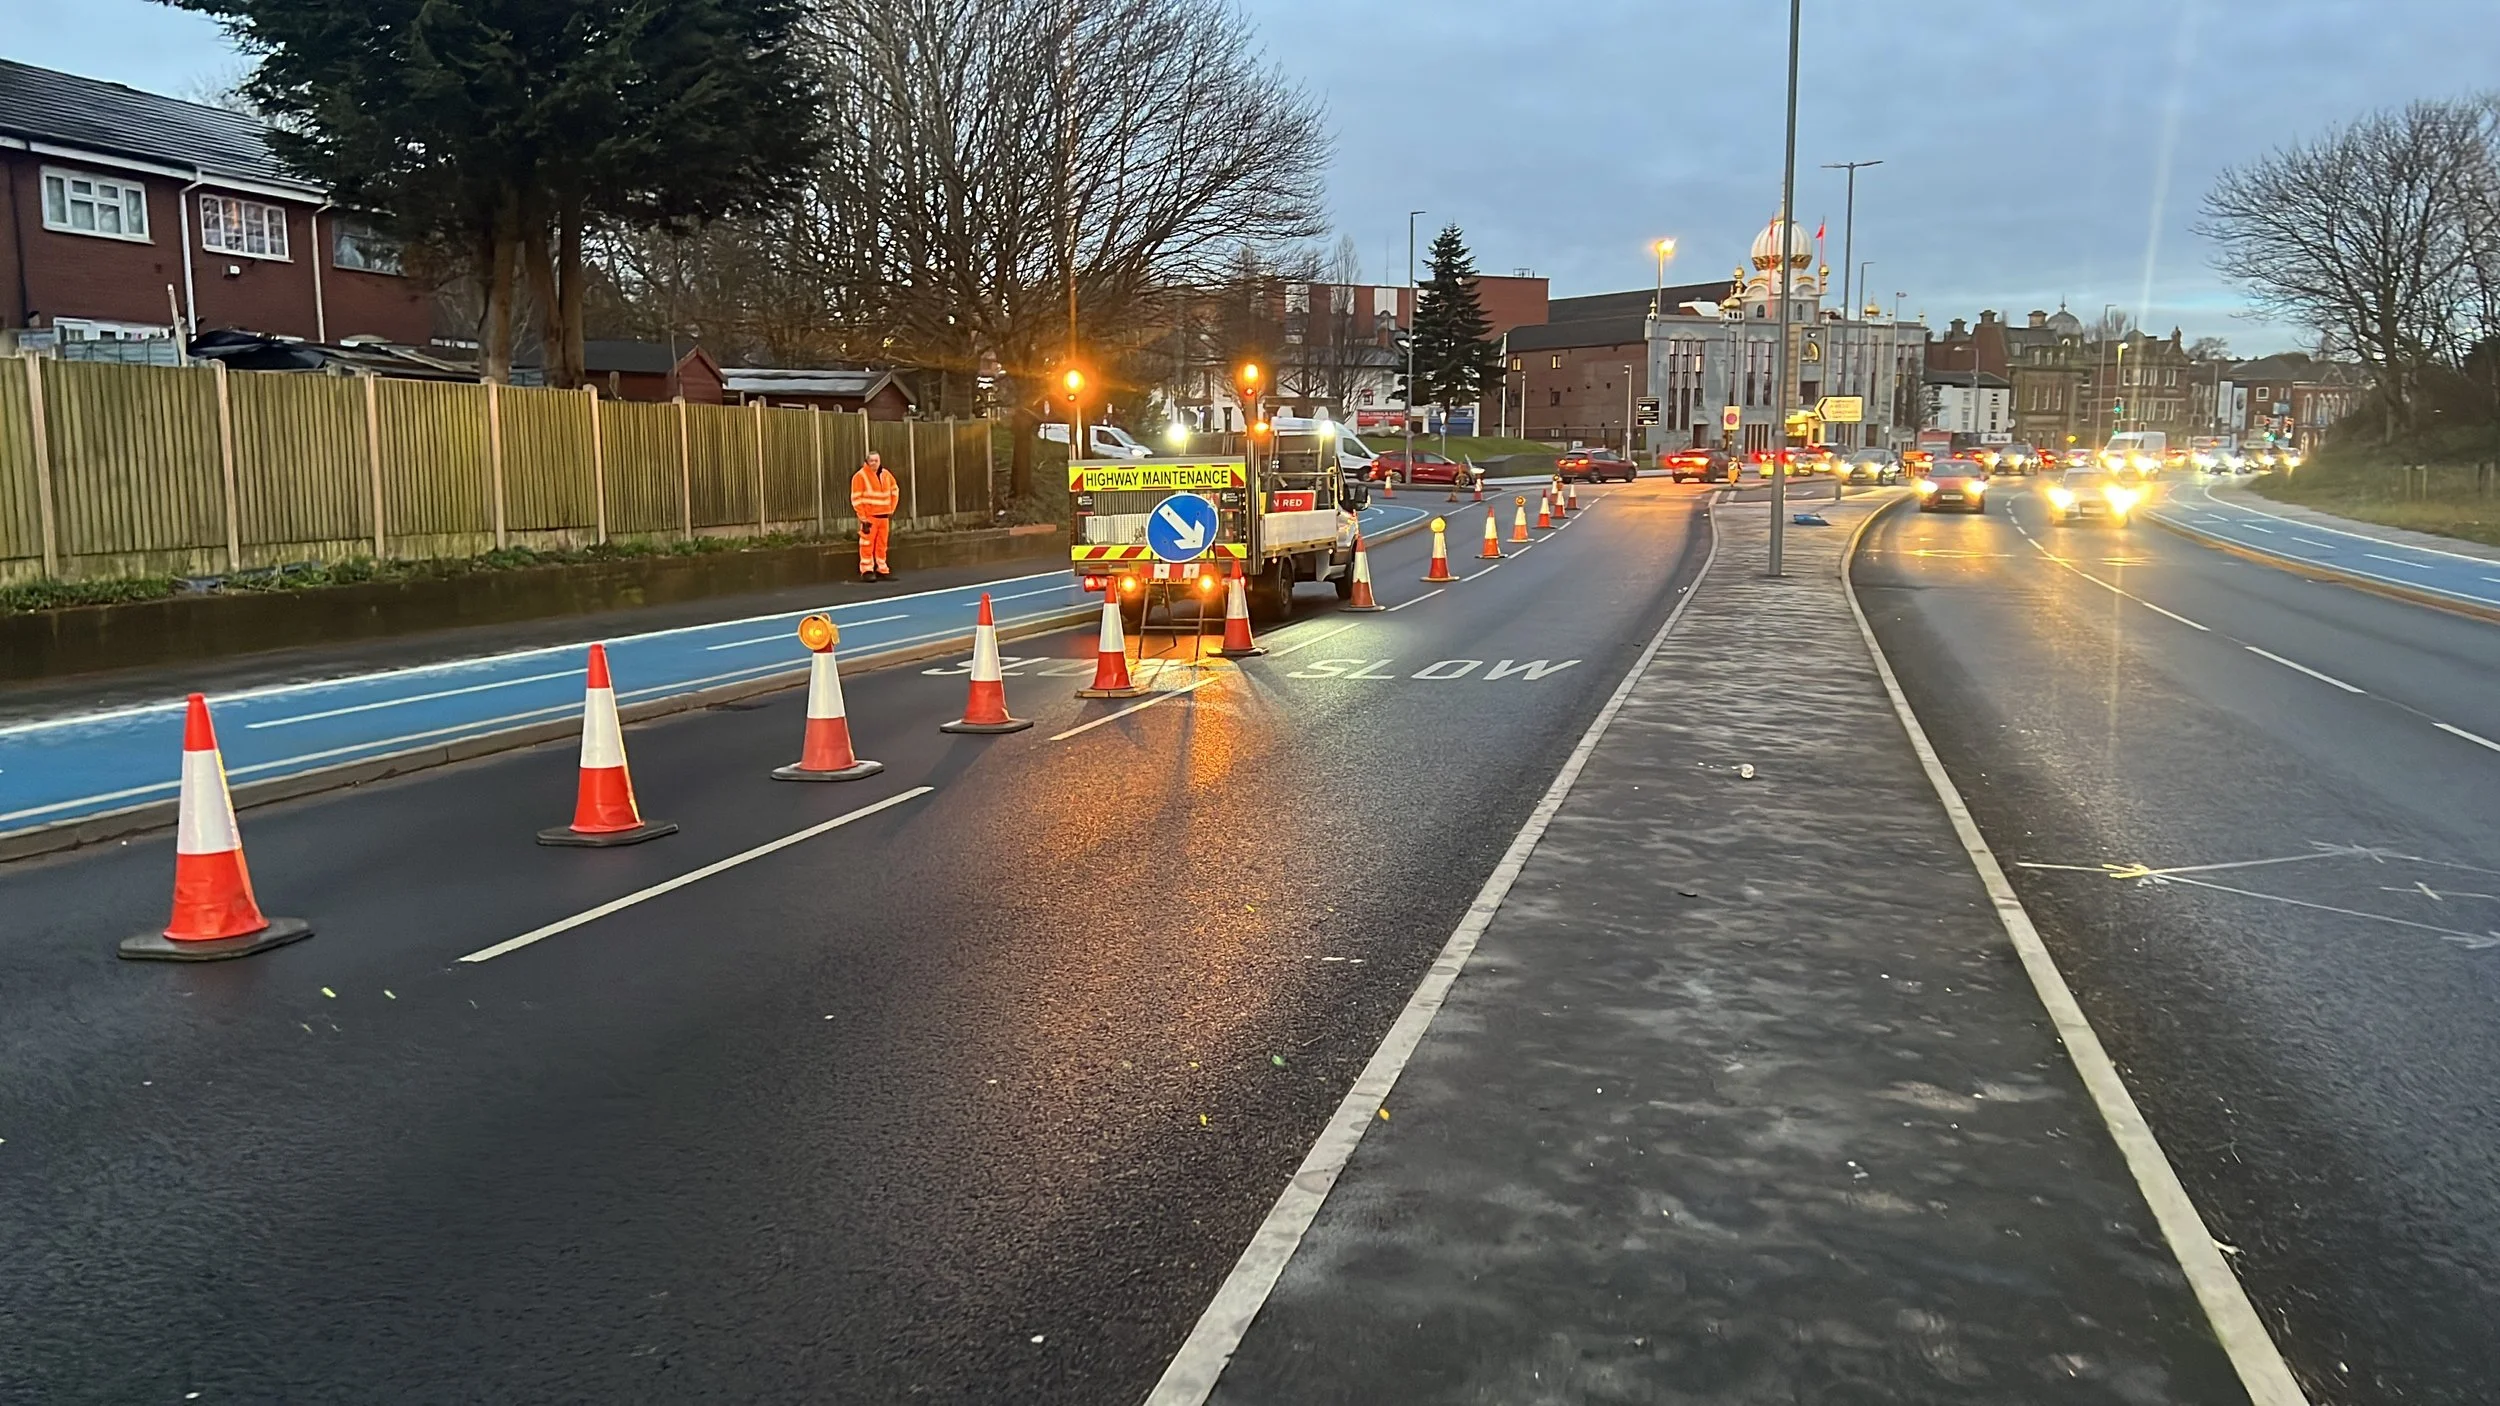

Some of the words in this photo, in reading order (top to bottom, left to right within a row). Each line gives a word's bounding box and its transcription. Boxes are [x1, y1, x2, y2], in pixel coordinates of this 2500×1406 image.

[1086, 472, 1139, 486] HIGHWAY
[1142, 470, 1228, 485] MAINTENANCE
[1282, 499, 1303, 507] RED
[1286, 658, 1583, 681] SLOW
